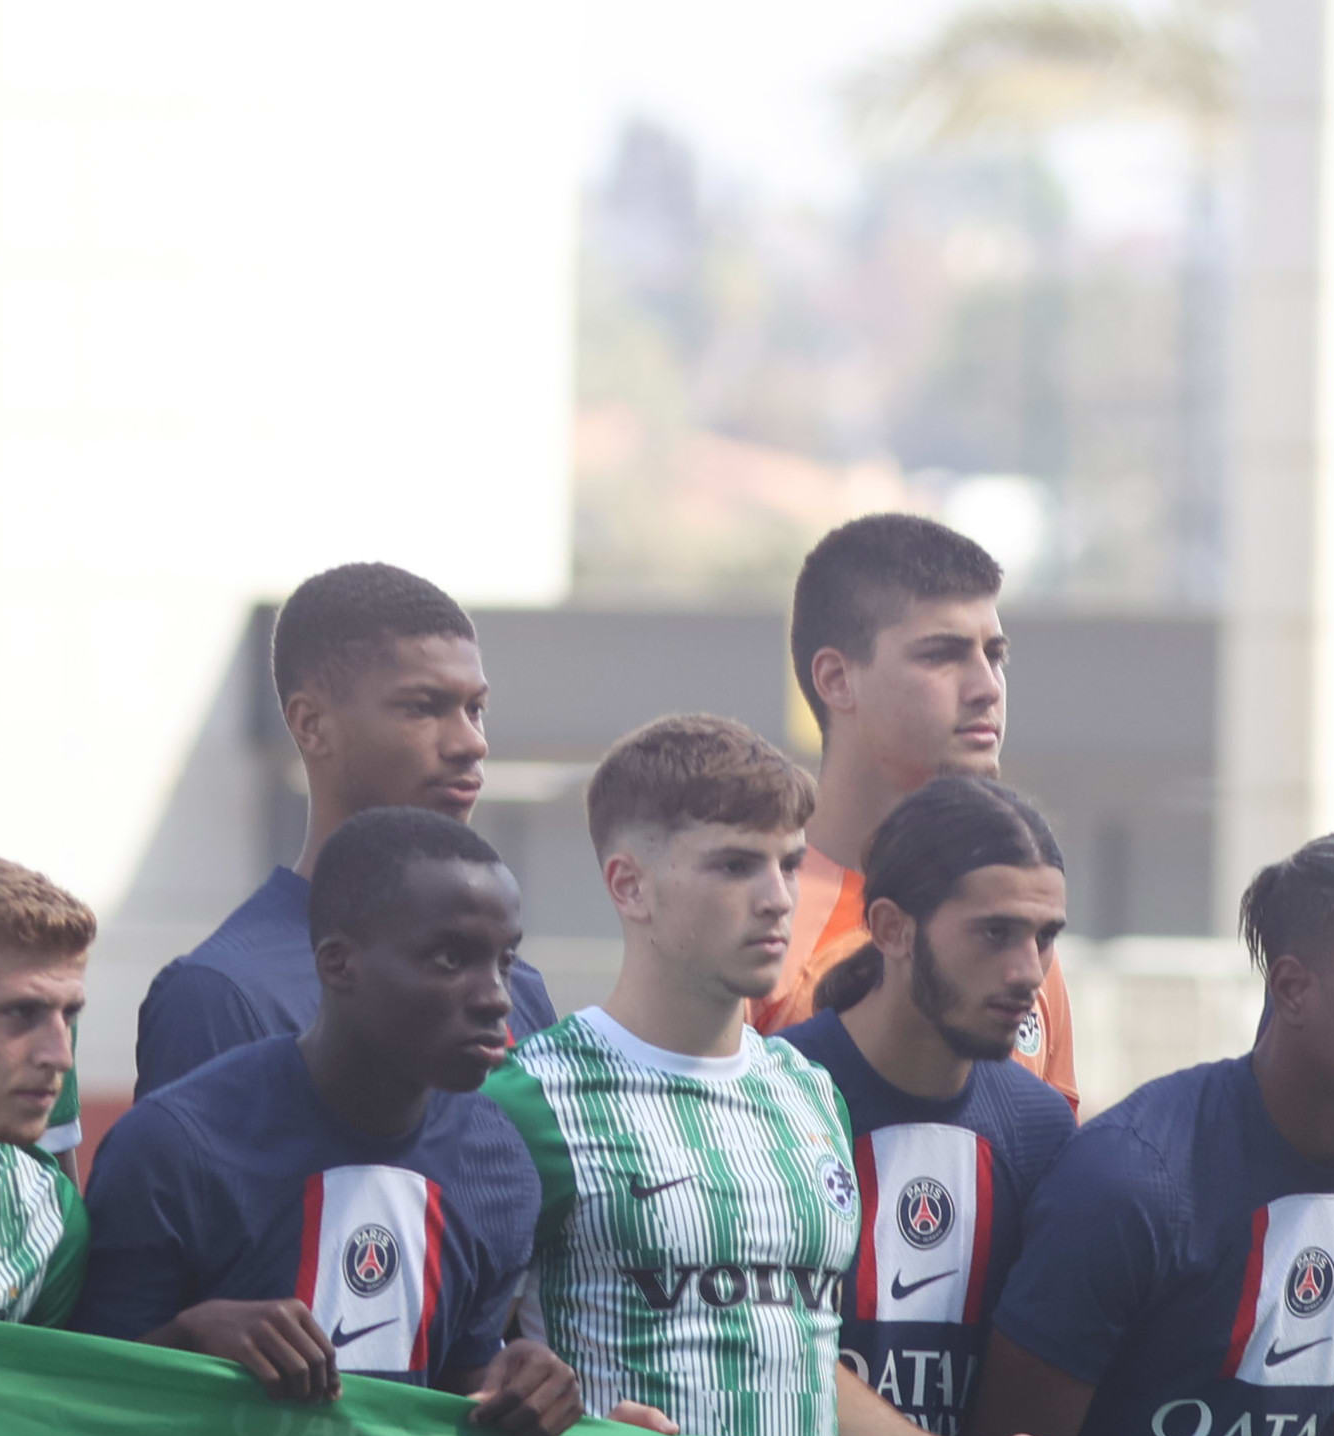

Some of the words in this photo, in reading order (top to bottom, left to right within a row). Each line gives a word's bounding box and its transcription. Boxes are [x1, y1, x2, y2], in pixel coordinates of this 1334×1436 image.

[906, 1182, 943, 1200] PARIS
[354, 1228, 390, 1248] PARIS
[1295, 1251, 1328, 1270] PARIS
